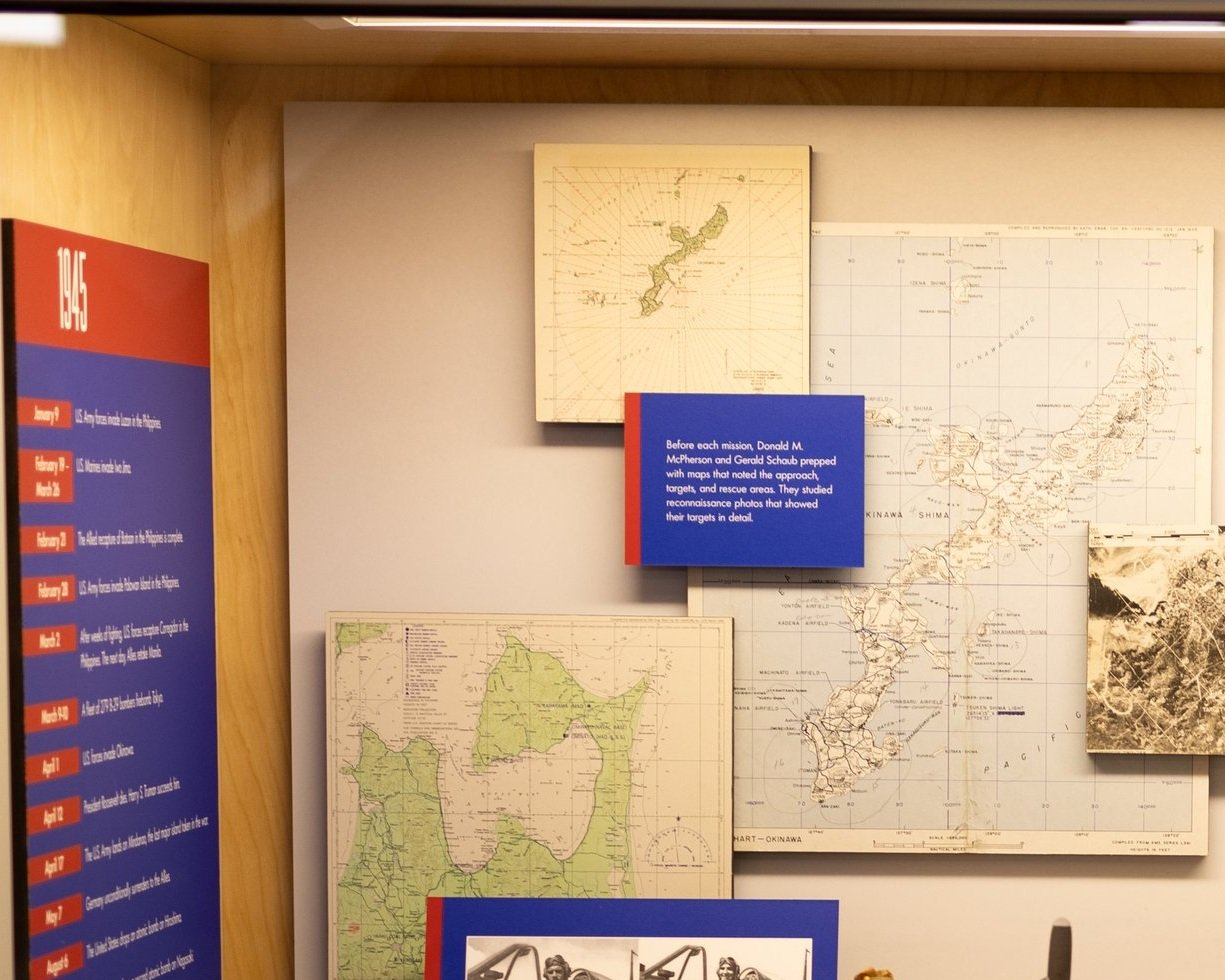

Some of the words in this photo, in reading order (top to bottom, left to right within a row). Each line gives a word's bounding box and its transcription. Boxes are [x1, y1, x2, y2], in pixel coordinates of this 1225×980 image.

[57, 247, 88, 332] 1945
[666, 439, 694, 449] Before
[696, 440, 719, 450] each
[721, 441, 754, 451] mission,
[757, 440, 789, 451] Donald
[791, 441, 803, 450] M.
[666, 454, 712, 464] McPherson
[714, 454, 731, 464] and
[733, 454, 764, 465] Gerald
[766, 455, 798, 465] Schaub
[800, 456, 836, 467] prepped
[665, 468, 684, 478] with
[687, 471, 711, 480] maps
[712, 468, 729, 479] that
[731, 469, 756, 479] noted
[759, 469, 773, 479] the
[775, 470, 819, 481] approach,
[665, 484, 696, 495] targets,
[699, 483, 716, 493] and
[749, 486, 775, 494] areas.
[778, 483, 799, 496] They
[802, 484, 833, 494] studied
[666, 499, 731, 507] reconnaissance
[734, 498, 763, 509] photos
[765, 498, 782, 508] that
[784, 498, 818, 508] showed
[665, 511, 684, 521] their
[686, 513, 716, 524] targets
[717, 513, 726, 521] in
[728, 512, 753, 522] detail.
[865, 511, 903, 519] KINAWA
[918, 511, 949, 519] SHIMA
